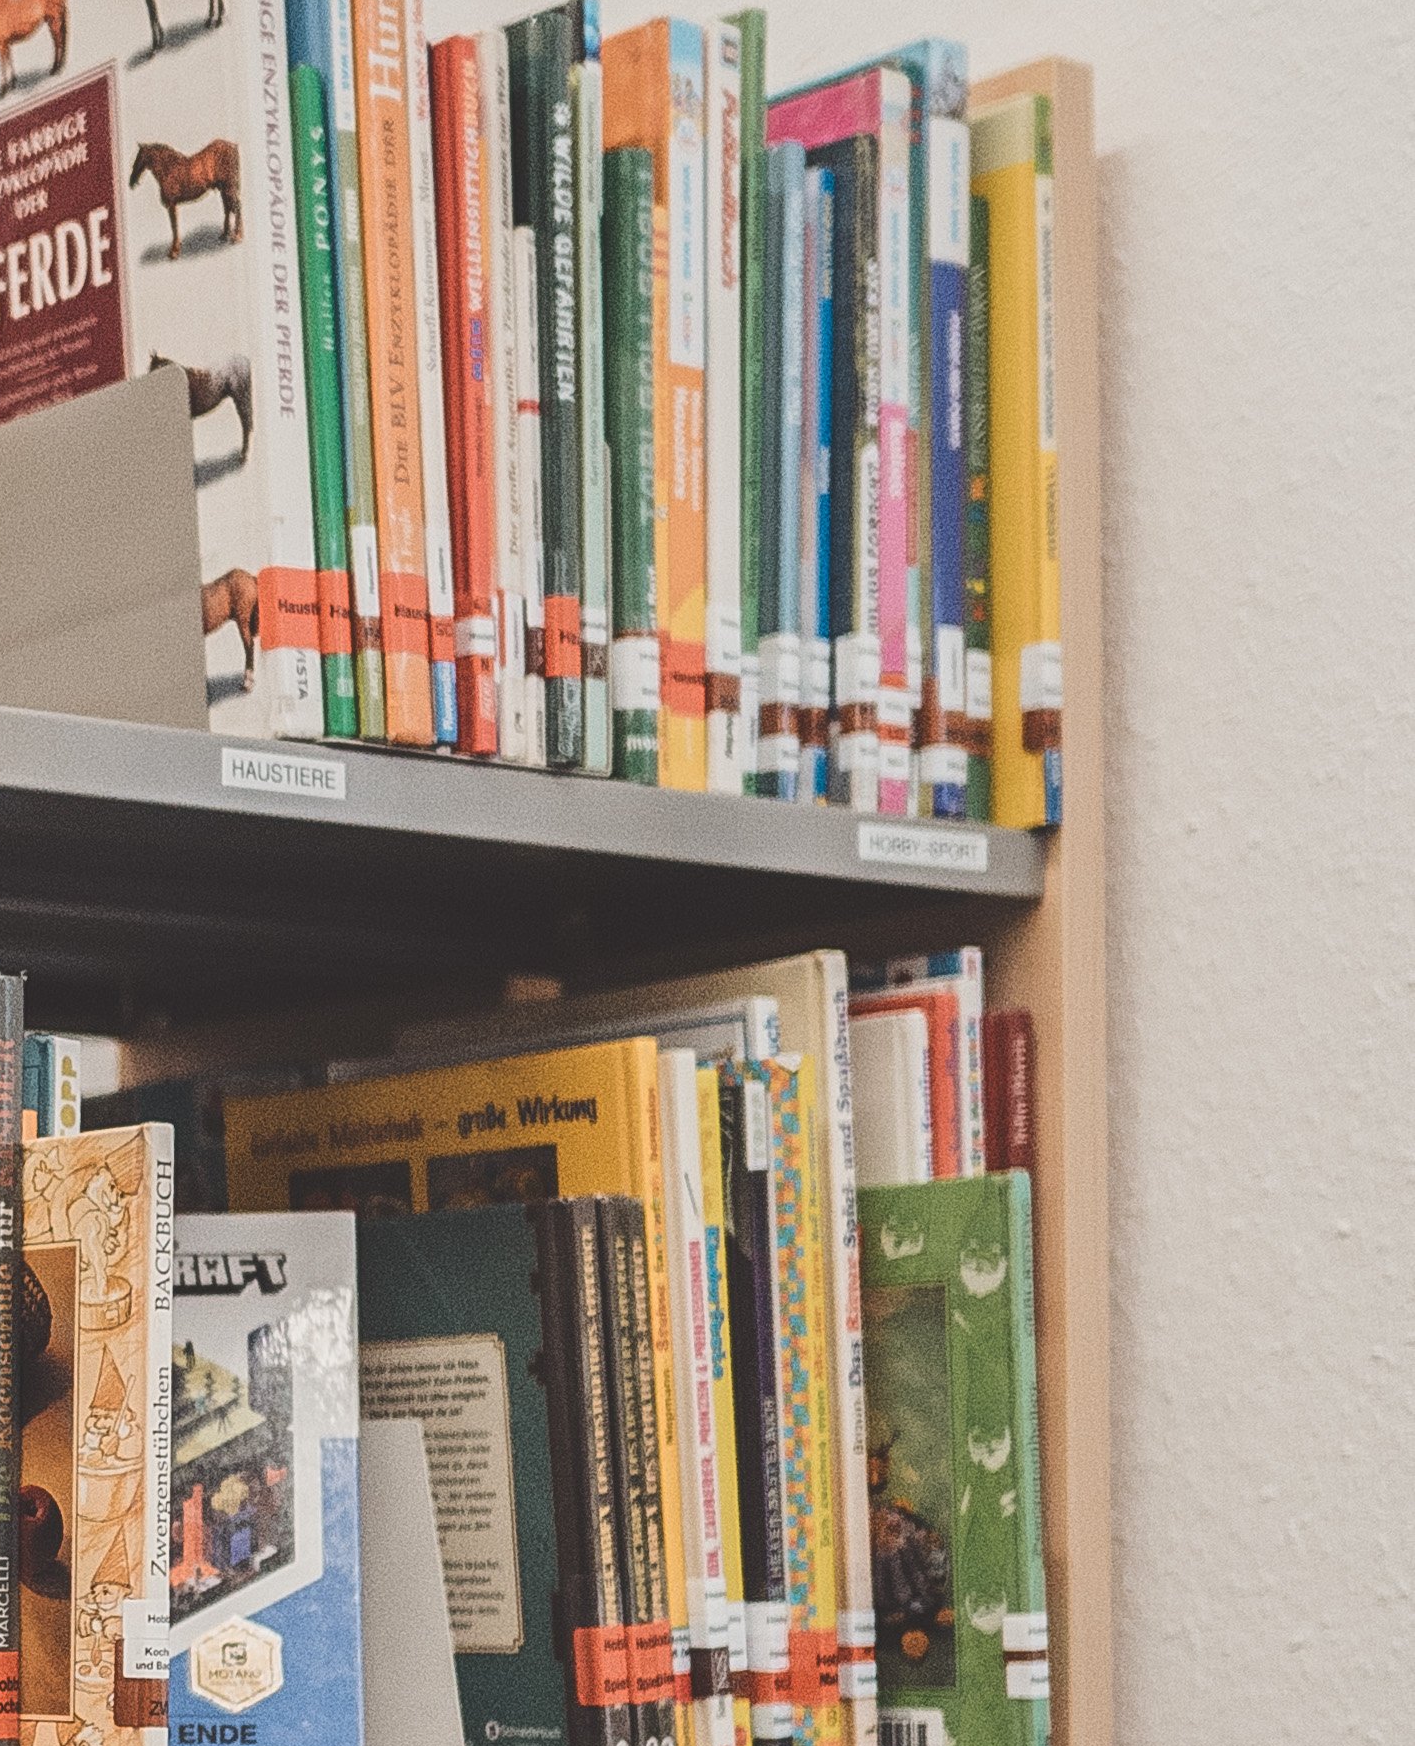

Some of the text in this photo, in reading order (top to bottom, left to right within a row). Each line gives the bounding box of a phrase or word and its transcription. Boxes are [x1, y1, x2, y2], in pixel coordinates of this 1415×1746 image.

[7, 110, 89, 166] FARBIGE
[259, 29, 289, 232] ENZYKLOPÄDIE
[314, 122, 333, 252] PONYS
[271, 238, 289, 294] DER
[276, 302, 295, 421] PFERDE
[231, 757, 337, 791] HAUSTIERE
[151, 1160, 173, 1577] Zwergenstübchen BACKBUCH
[177, 1721, 257, 1746] ENDE
